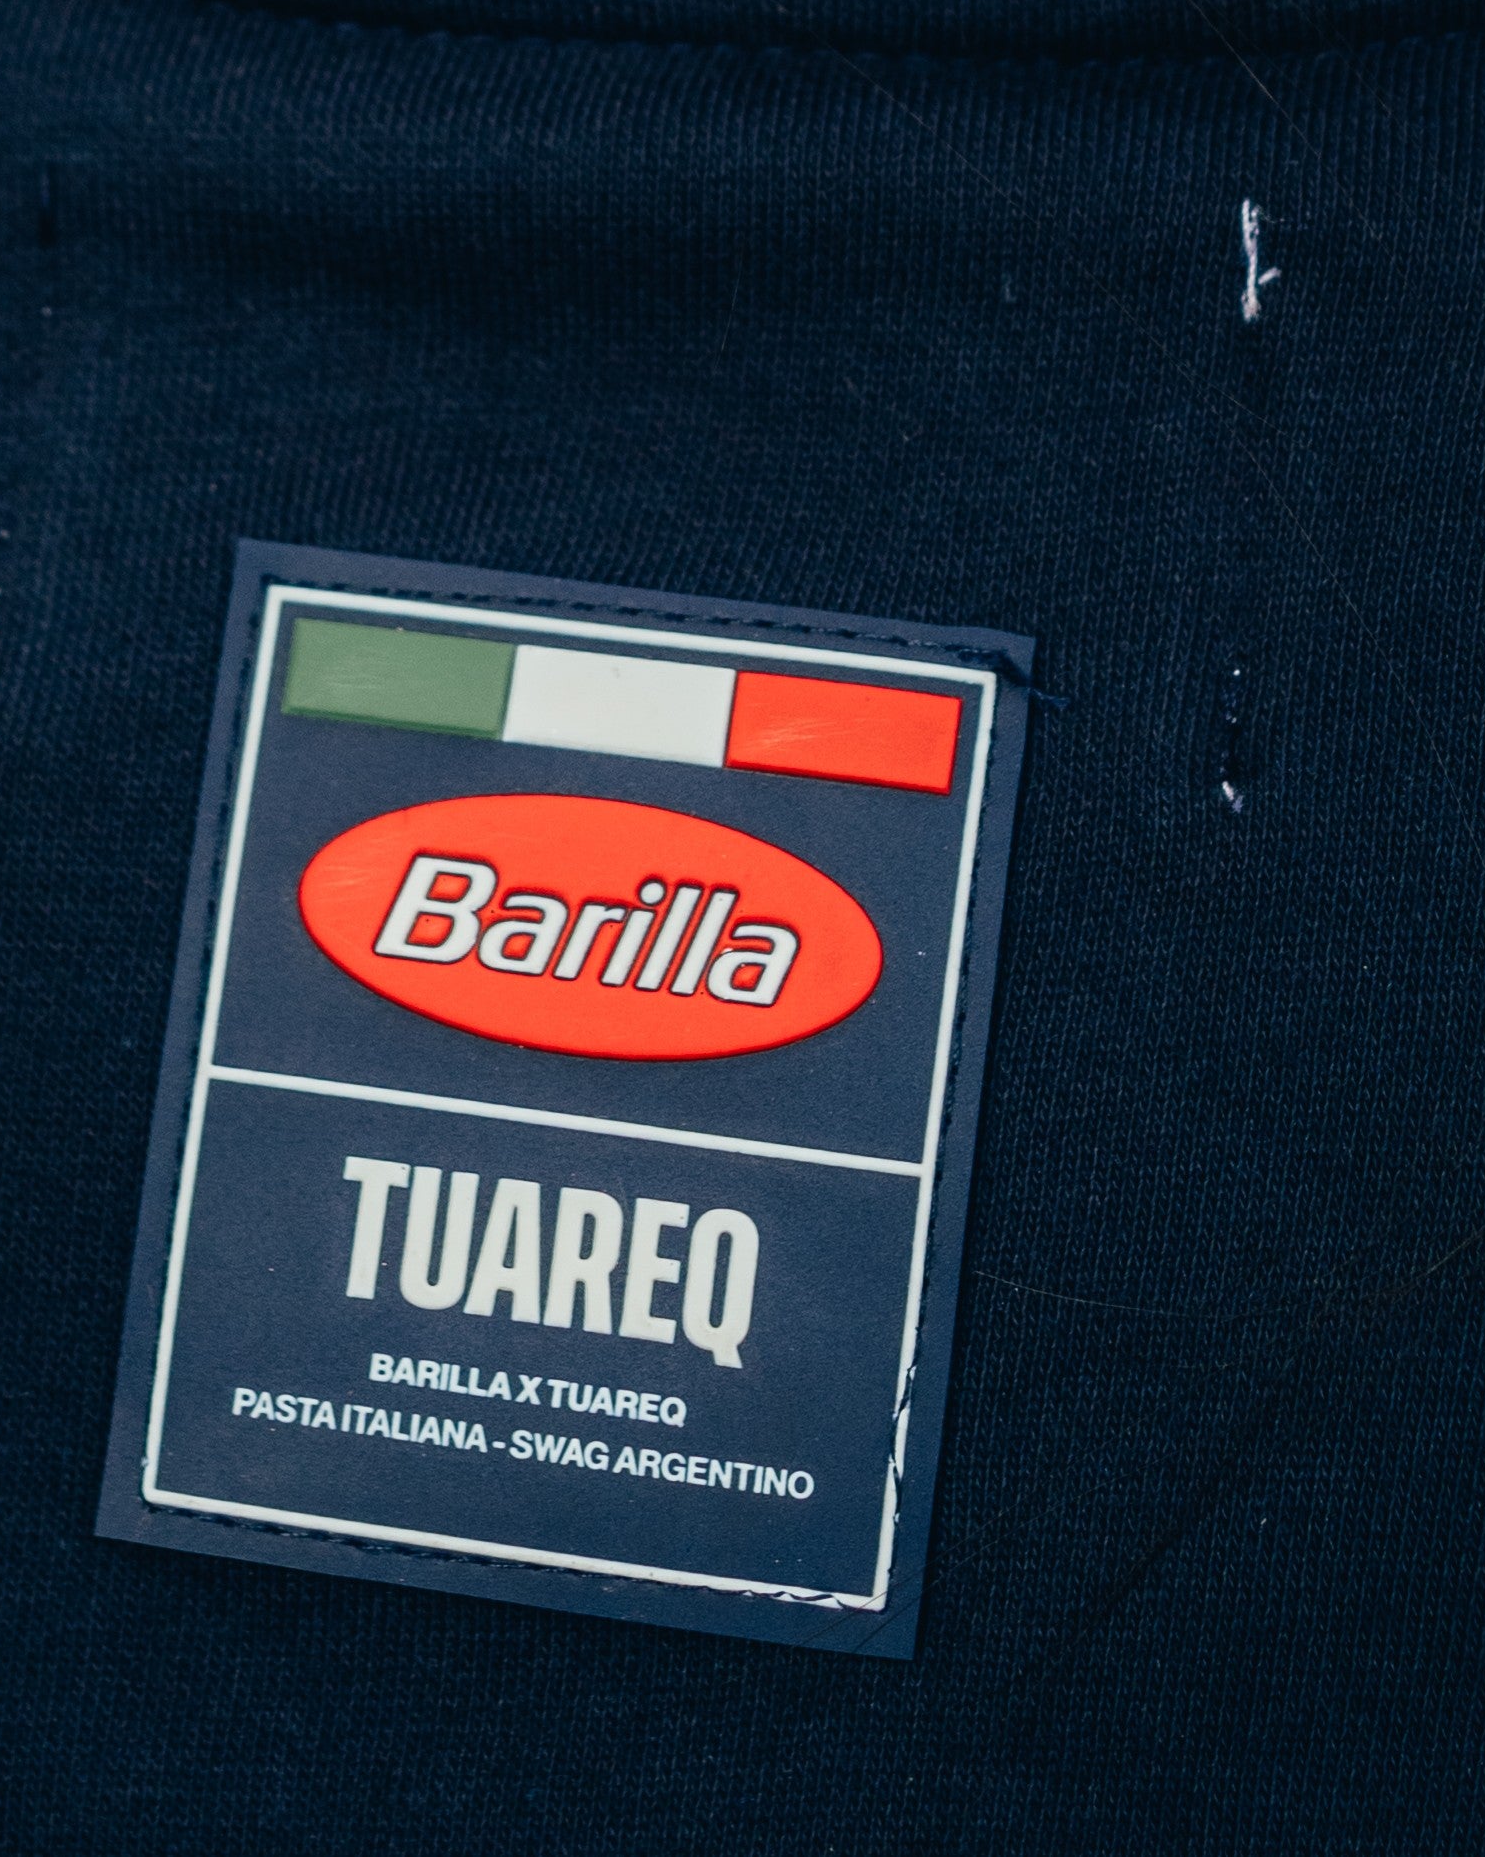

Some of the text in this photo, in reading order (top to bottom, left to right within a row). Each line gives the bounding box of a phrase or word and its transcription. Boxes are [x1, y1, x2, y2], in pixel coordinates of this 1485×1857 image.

[374, 850, 800, 1007] Barilla
[342, 1154, 760, 1369] TUAREQ
[232, 1387, 336, 1430] PASTA
[340, 1404, 488, 1454] ITALIANA
[508, 1430, 611, 1472] SWAG
[613, 1447, 815, 1500] ARGENTINO
[368, 1352, 686, 1428] BARILLA X TUAREQ
